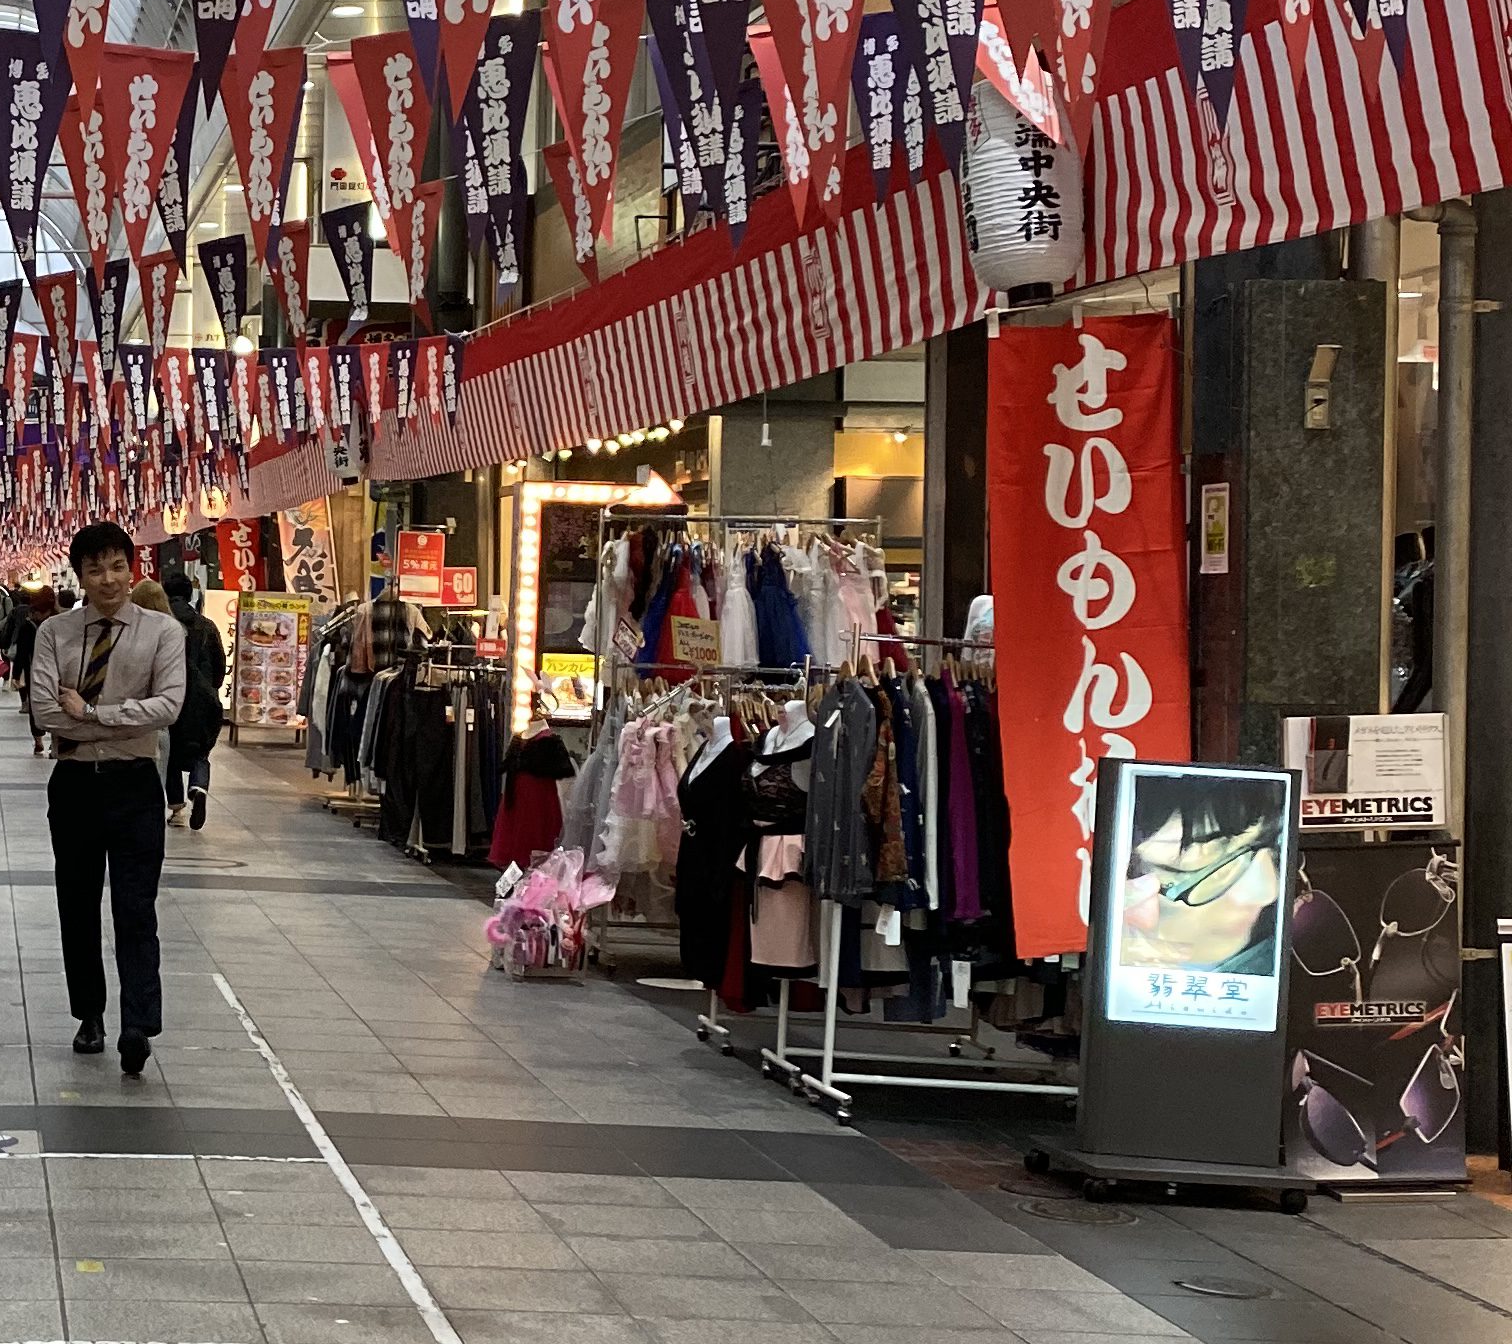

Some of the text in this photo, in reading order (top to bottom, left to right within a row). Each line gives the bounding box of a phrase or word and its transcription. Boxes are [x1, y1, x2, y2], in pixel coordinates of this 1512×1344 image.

[10, 81, 43, 210] 恵比須講
[123, 75, 158, 223] せいもん払い
[248, 71, 274, 221] せいもん払い
[384, 53, 415, 209] せいもん払い
[478, 57, 511, 196] 恵比須講
[868, 54, 895, 169] 恵比須講
[1043, 334, 1153, 927] せいもん払
[1302, 797, 1433, 815] EYEMETRICS
[1147, 973, 1249, 1002] 翡翠堂
[1316, 1003, 1425, 1017] EYEMETRICS
